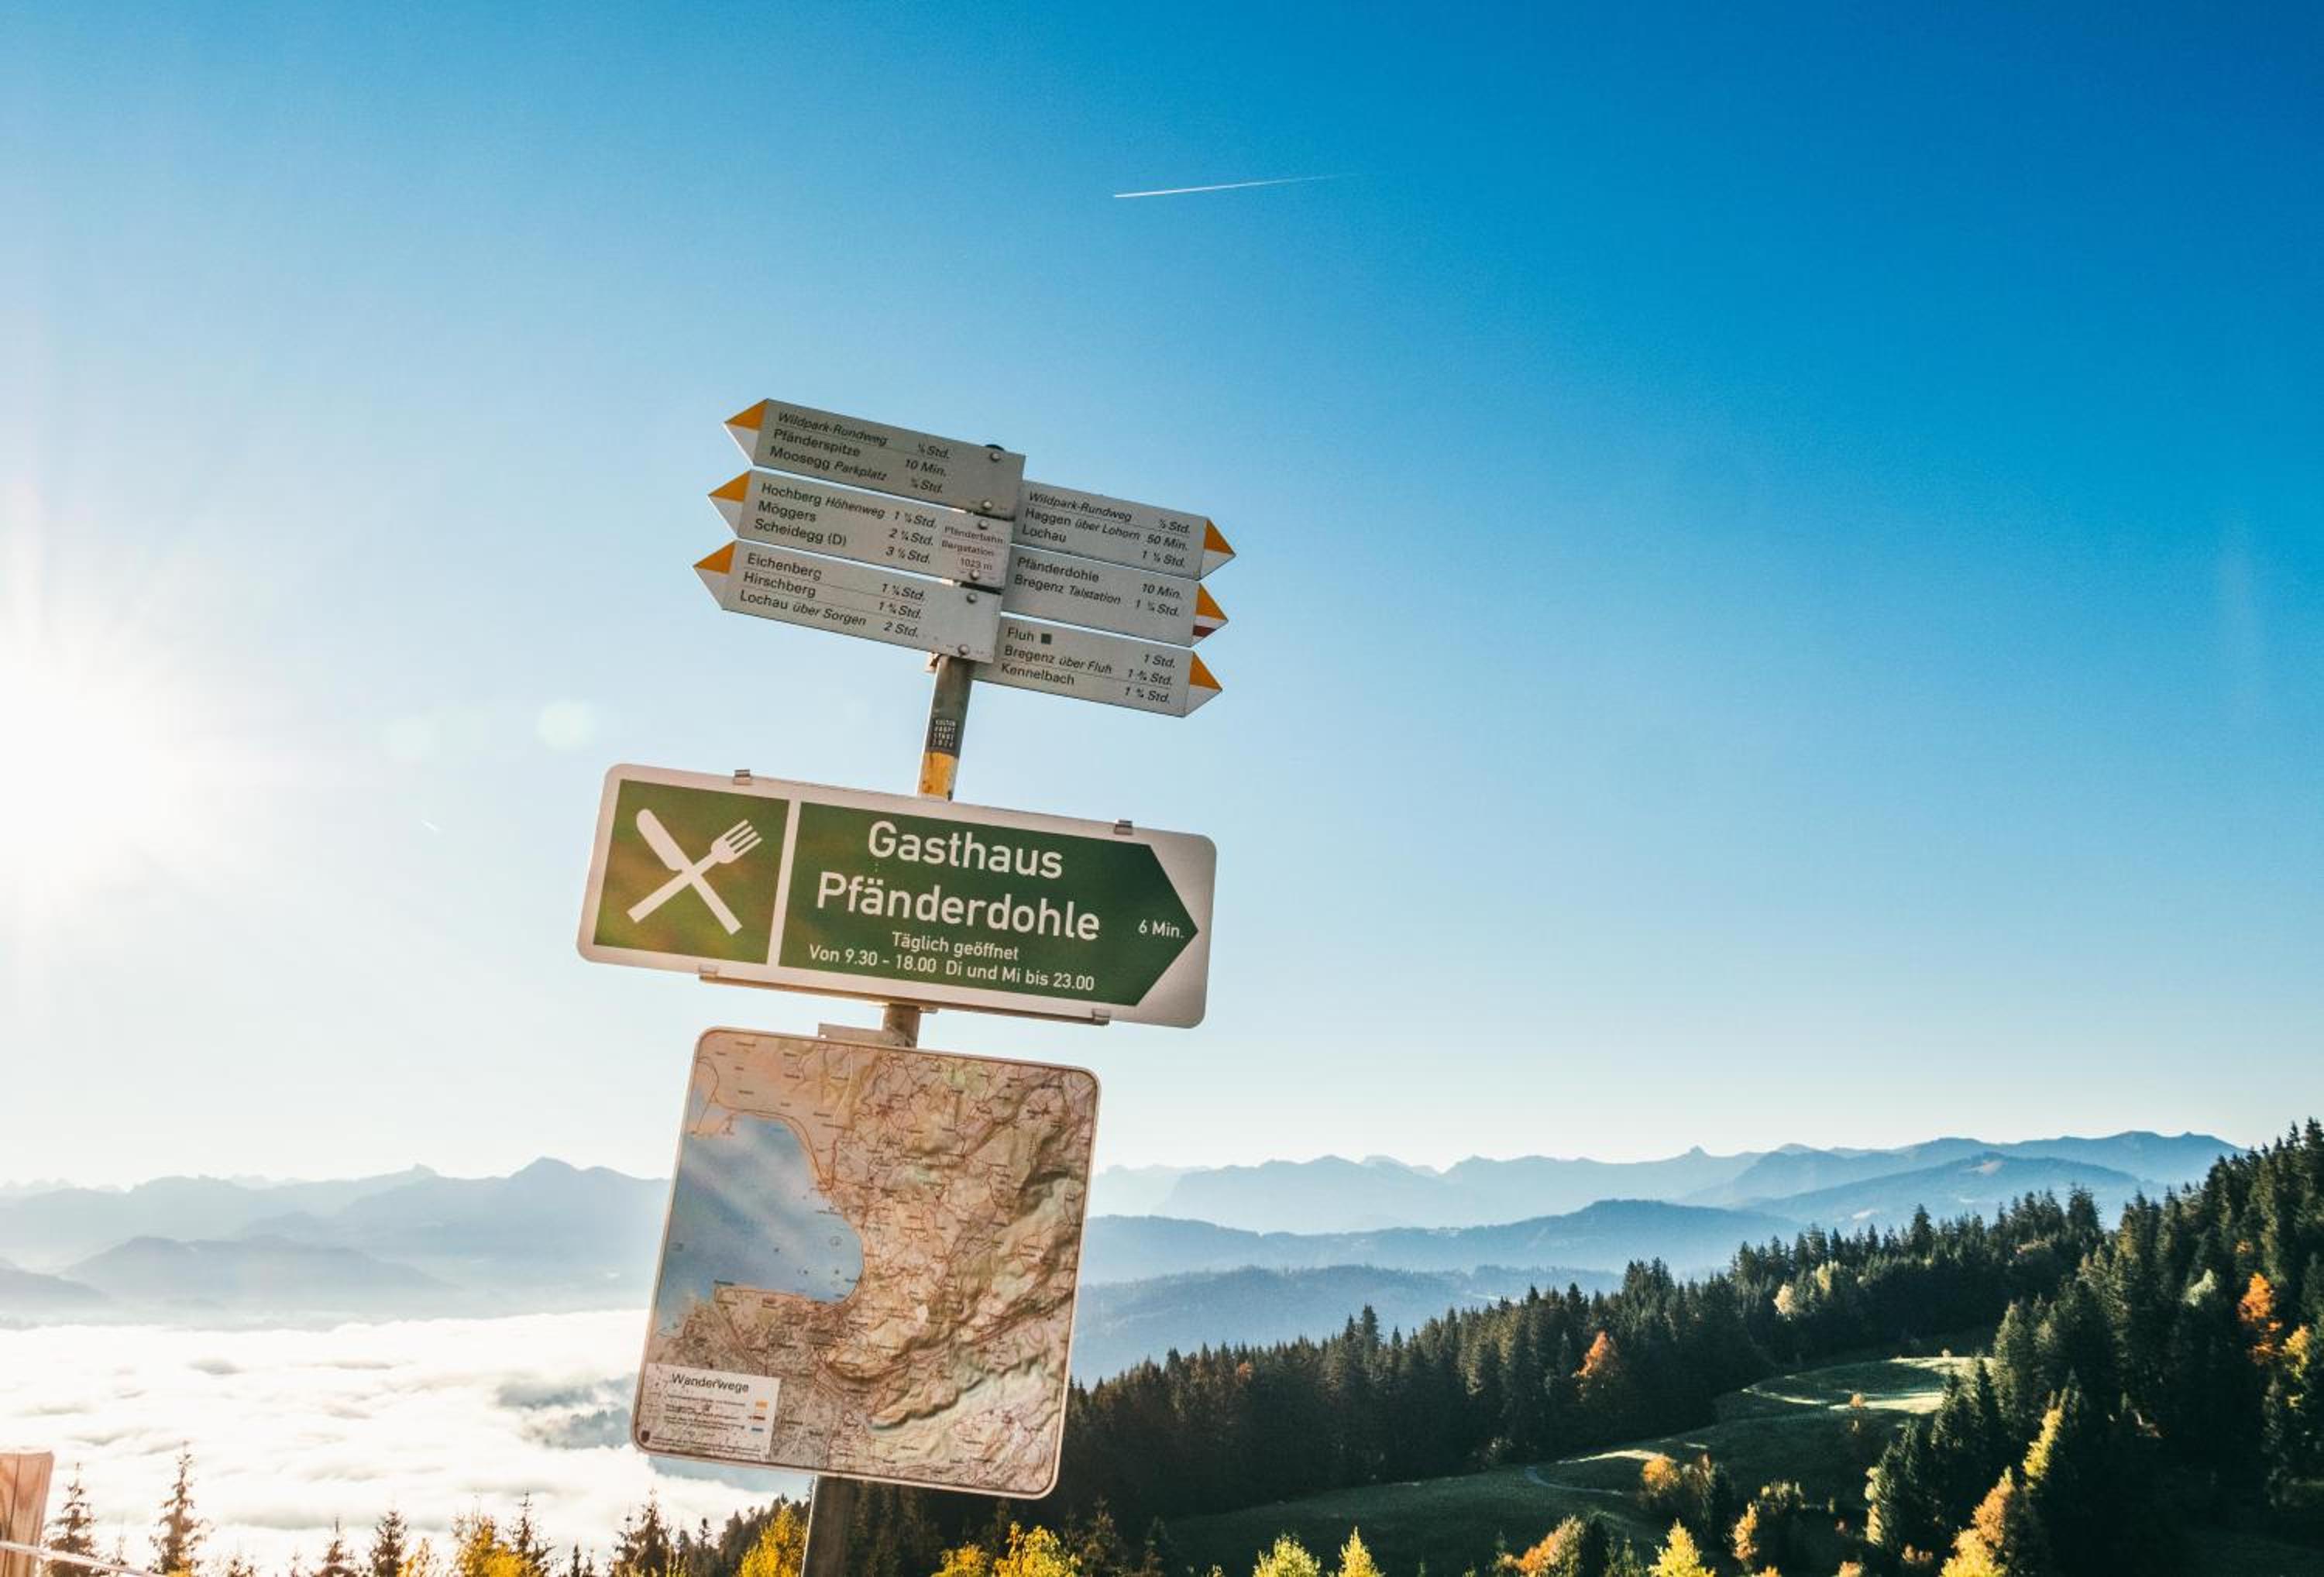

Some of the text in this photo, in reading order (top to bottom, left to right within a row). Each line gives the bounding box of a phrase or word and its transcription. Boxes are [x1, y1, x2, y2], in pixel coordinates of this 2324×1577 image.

[774, 428, 947, 477] Pfänderspitze 10 Min.
[779, 411, 889, 446] Wildpark-Rundweg
[927, 445, 951, 459] Std.
[770, 446, 830, 470] Moosegg
[834, 461, 887, 481] Parkplatz
[920, 479, 943, 493] Std.
[758, 500, 816, 522] Möggers
[889, 528, 897, 538] 2
[910, 532, 933, 546] Std.
[761, 483, 822, 507] Hochberg
[825, 496, 885, 520] Höhenweg
[894, 511, 899, 521] 1
[913, 515, 937, 528] Std.
[1030, 491, 1131, 522] Wildpark-Rundweg
[1169, 521, 1190, 534] Std.
[755, 518, 823, 544] Scheidegg
[827, 532, 847, 546] (D)
[885, 546, 894, 556] 3
[907, 550, 930, 564] Std.
[942, 540, 994, 556] Bergstation
[945, 526, 1003, 544] Pfänderbahn
[1023, 525, 1066, 543] Lochau
[1163, 554, 1185, 568] Std.
[1025, 507, 1188, 551] Haggen über Lohorn 50 Min.
[744, 571, 816, 598] Hirschberg
[878, 601, 885, 610] 1
[898, 604, 922, 619] Std.
[748, 552, 822, 581] Eichenberg
[882, 583, 888, 593] 1
[901, 586, 925, 601] Std.
[1015, 573, 1064, 593] Bregenz
[1069, 585, 1121, 604] Talstation
[1136, 599, 1140, 608] 1
[1157, 603, 1179, 617] Std.
[1017, 557, 1181, 600] Pfänderdohle 10 Min.
[741, 589, 918, 637] Lochau über Sorgen 2 Std.
[1005, 646, 1054, 664] Bregenz
[1059, 655, 1085, 669] über
[1087, 660, 1112, 674] Fluh
[1129, 669, 1133, 678] 1
[1150, 672, 1173, 685] Std.
[1008, 626, 1175, 668] Fluh 1 Std.
[1002, 663, 1074, 685] Kennelbach
[1125, 687, 1130, 696] 1
[1147, 690, 1170, 704] Std.
[868, 820, 1062, 879] Gasthaus
[817, 871, 1100, 941] Pfänderdohle
[892, 932, 1019, 962] Täglich geöffnet
[1138, 919, 1184, 940] 6 Min.
[809, 943, 840, 964] Von
[844, 948, 878, 967] 9.30
[896, 953, 937, 974] 18.00
[946, 960, 961, 977] Di
[967, 961, 997, 981] und
[1002, 966, 1021, 983] Mi
[1025, 969, 1049, 986] bis
[1053, 972, 1095, 991] 23.00
[672, 1373, 749, 1393] Wanderwege
